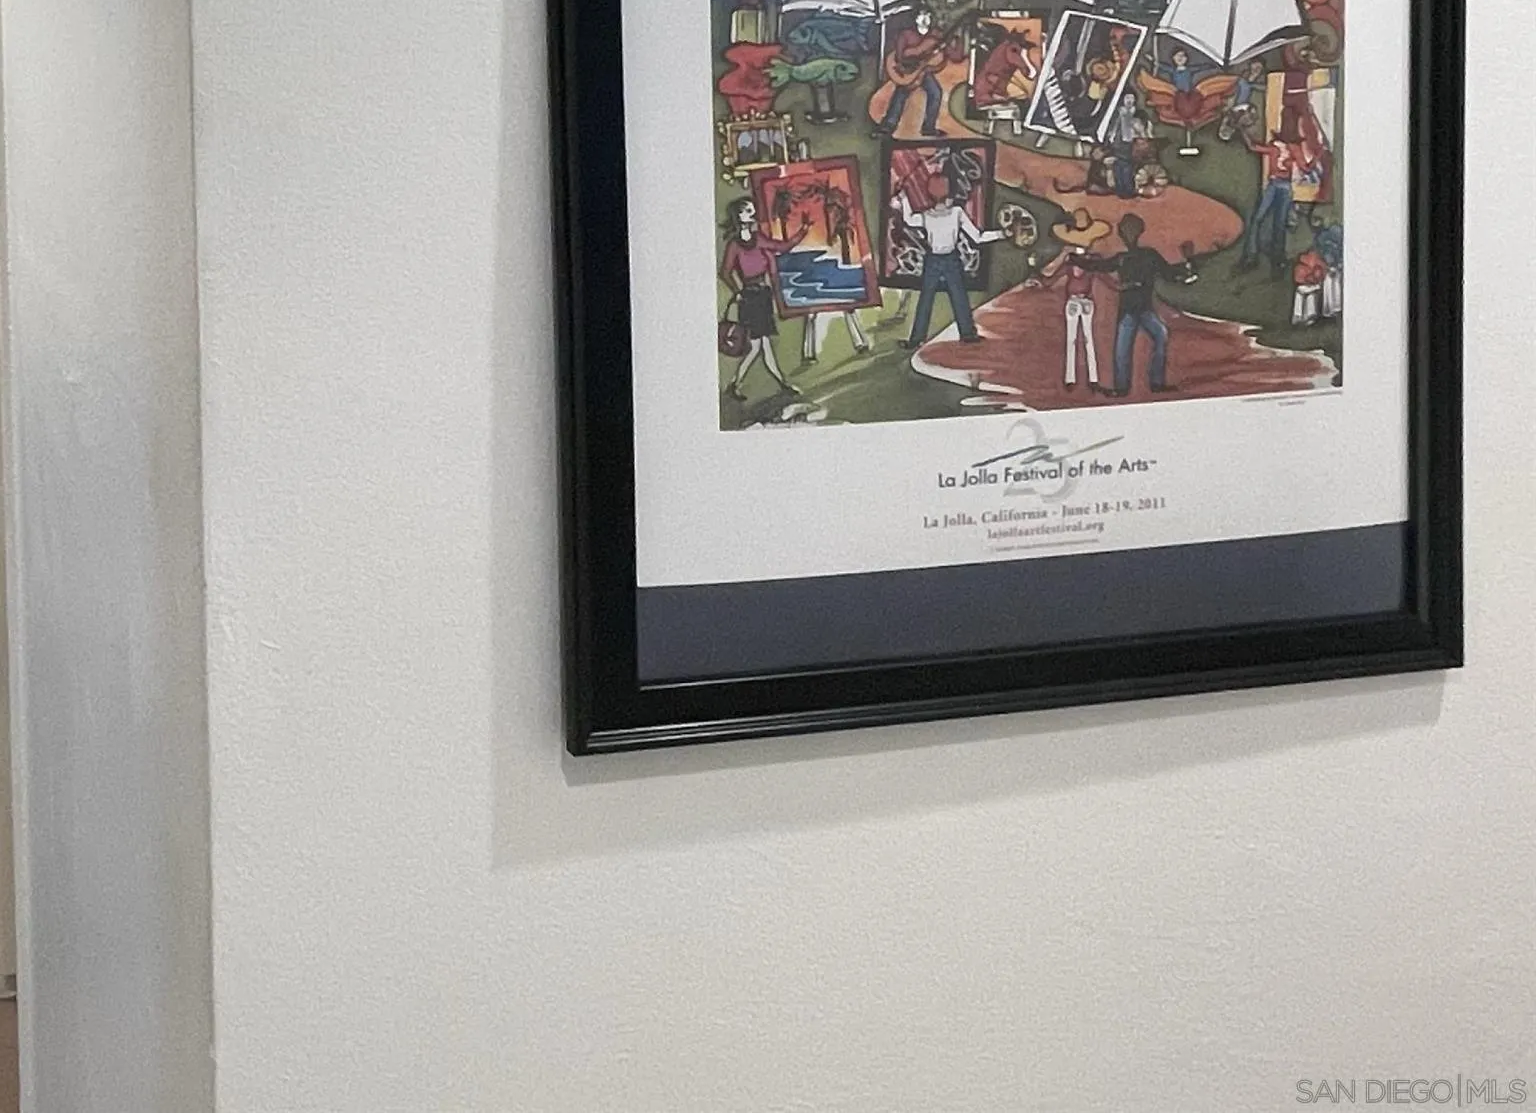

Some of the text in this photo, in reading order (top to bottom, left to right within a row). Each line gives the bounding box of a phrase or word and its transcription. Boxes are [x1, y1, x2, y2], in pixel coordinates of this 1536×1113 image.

[938, 472, 956, 488] La
[961, 468, 998, 488] Jolla
[1004, 461, 1063, 483] Festival
[1068, 460, 1085, 478] of
[1089, 458, 1113, 476] the
[923, 516, 939, 529] La
[981, 508, 1048, 524] California
[1062, 505, 1091, 519] June
[1137, 497, 1166, 510] 2011
